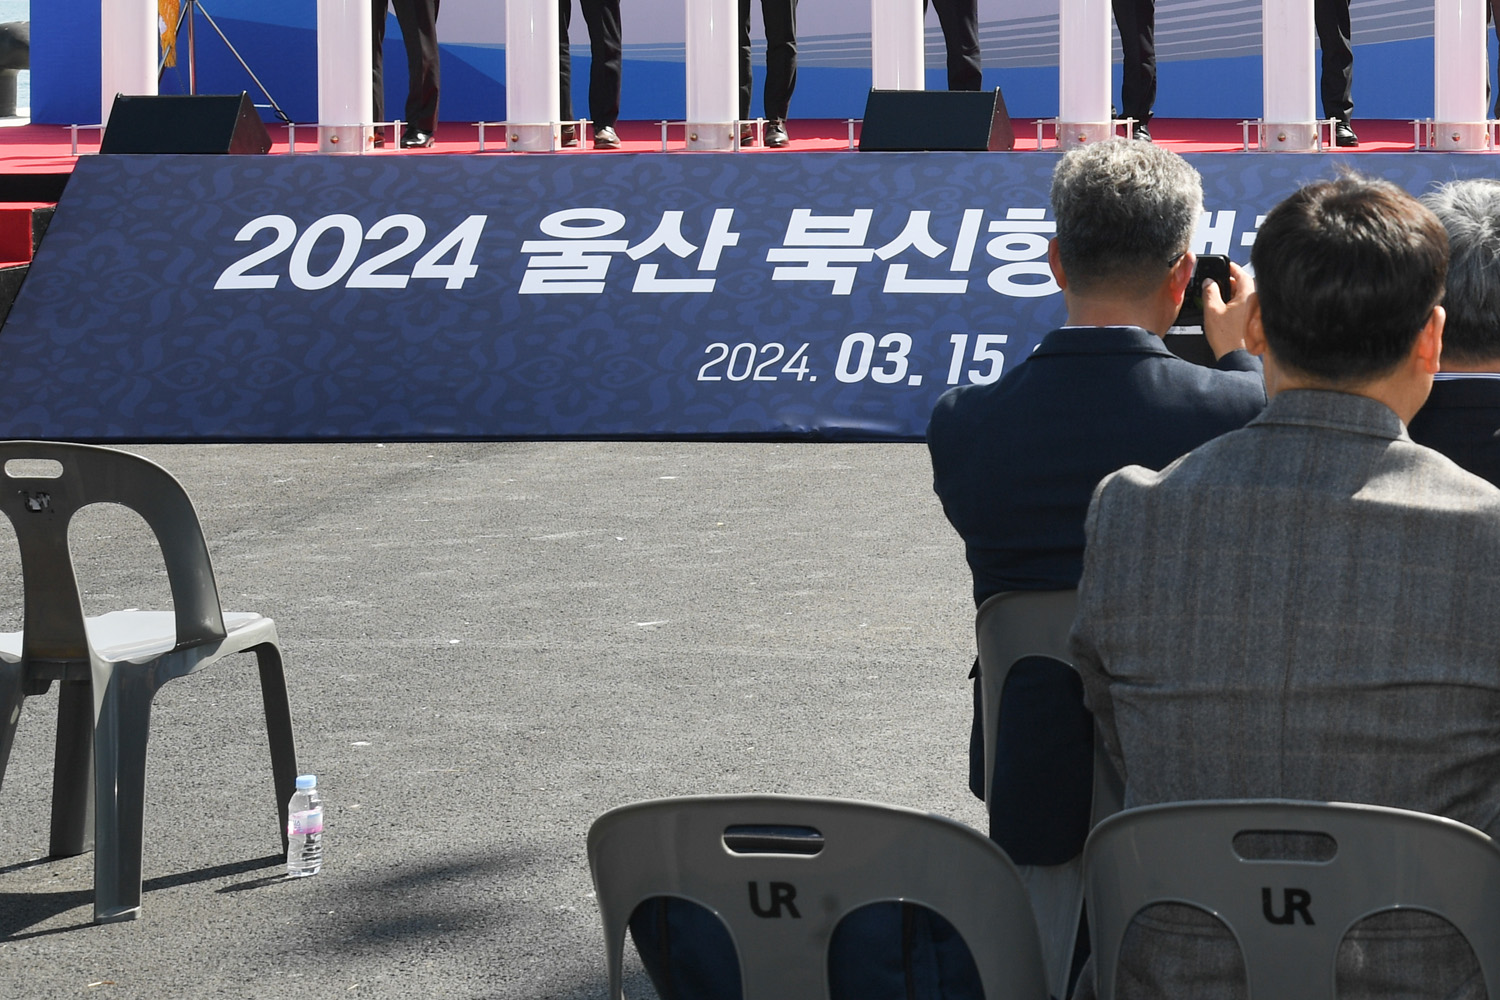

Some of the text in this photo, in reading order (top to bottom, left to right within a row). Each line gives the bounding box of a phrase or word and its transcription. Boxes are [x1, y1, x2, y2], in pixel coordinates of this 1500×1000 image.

[213, 213, 488, 291] 2024
[518, 207, 740, 294] 울산
[766, 207, 1064, 297] 북신항
[697, 342, 818, 382] 2024.
[834, 332, 923, 386] 03.
[747, 880, 802, 920] UR
[1261, 886, 1316, 926] UR
